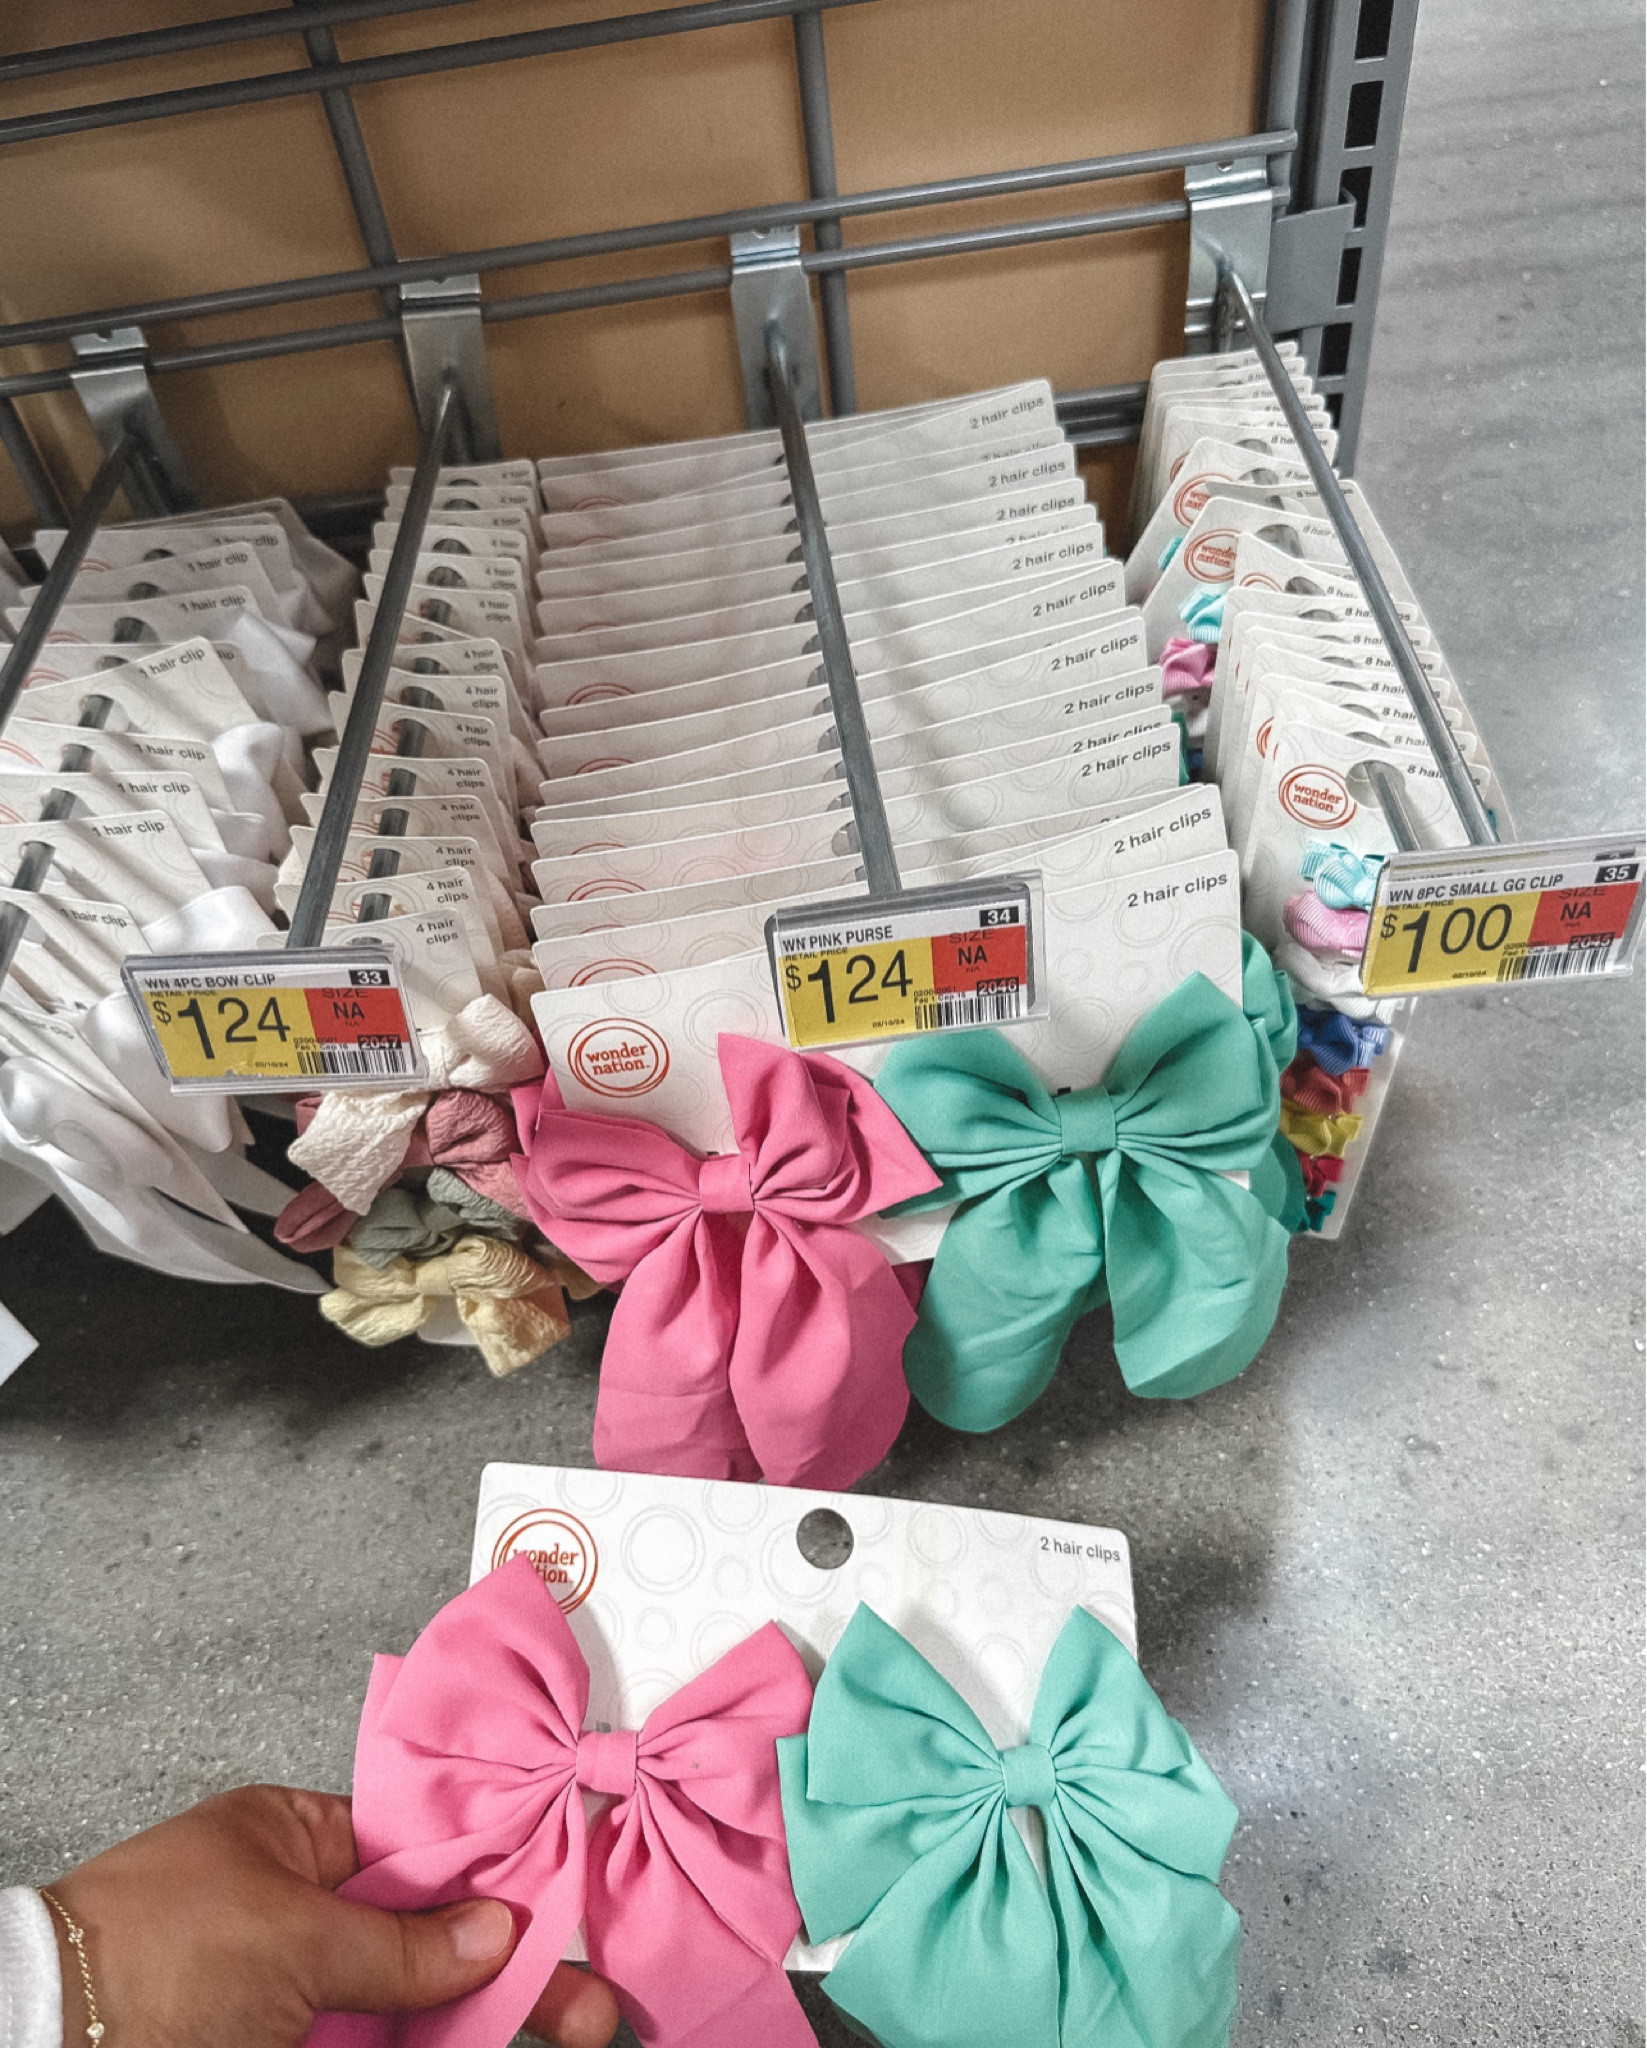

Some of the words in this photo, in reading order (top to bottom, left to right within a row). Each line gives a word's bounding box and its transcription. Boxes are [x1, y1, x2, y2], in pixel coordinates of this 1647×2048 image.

[981, 409, 1008, 426] hair
[1011, 397, 1044, 415] clips
[988, 476, 997, 487] 2
[1000, 469, 1029, 485] hair
[1032, 461, 1066, 477] clips
[996, 510, 1006, 520] 2
[1009, 504, 1038, 519] hair
[1041, 497, 1075, 512] clips
[226, 552, 248, 565] clip
[1013, 559, 1021, 570] 2
[1025, 551, 1055, 567] hair
[1058, 542, 1094, 558] clips
[220, 595, 246, 607] clip
[1032, 604, 1042, 617] 2
[1046, 594, 1076, 613] hair
[1080, 581, 1115, 600] clips
[1345, 608, 1352, 616] 8
[1355, 608, 1372, 617] ha
[1052, 658, 1060, 671] 2
[1065, 648, 1096, 667] hair
[1100, 634, 1138, 654] clips
[139, 668, 149, 679] 1
[149, 658, 176, 676] hair
[180, 647, 206, 665] clip
[1365, 657, 1372, 665] 8
[1371, 683, 1379, 691] 8
[1064, 702, 1074, 715] 2
[1078, 694, 1111, 710] hair
[1115, 682, 1154, 700] clips
[1382, 707, 1390, 716] 8
[465, 725, 489, 734] hair
[463, 737, 491, 747] clips
[1073, 741, 1083, 753] 2
[1087, 732, 1120, 749] hair
[1394, 735, 1402, 744] 8
[1406, 736, 1427, 746] hai
[135, 743, 144, 753] 1
[149, 744, 174, 757] hair
[179, 748, 206, 761] clip
[1082, 764, 1092, 777] 2
[1096, 755, 1129, 773] hair
[1132, 741, 1171, 761] clips
[447, 768, 454, 776] 4
[457, 768, 482, 777] hair
[1407, 764, 1416, 774] 8
[1419, 766, 1441, 778] hai
[117, 783, 126, 793] 1
[129, 782, 159, 793] hair
[163, 782, 191, 795] clip
[456, 780, 485, 788] clips
[1294, 784, 1343, 804] wonder
[1293, 794, 1334, 813] nation
[92, 827, 101, 837] 1
[104, 823, 133, 835] hair
[137, 820, 165, 834] clip
[1114, 840, 1125, 854] 2
[1129, 826, 1164, 848] hair
[1169, 808, 1212, 832] clips
[447, 846, 473, 855] hair
[445, 858, 476, 867] clips
[1604, 866, 1631, 881] 35
[427, 882, 435, 891] 4
[438, 879, 464, 889] hair
[1127, 893, 1139, 908] 2
[1143, 885, 1180, 904] hair
[1184, 873, 1227, 894] clips
[1389, 890, 1413, 902] WN
[1417, 886, 1445, 899] 8PC
[1449, 881, 1499, 896] SMALL
[1503, 878, 1526, 892] GG
[1530, 874, 1563, 888] CLIP
[1559, 887, 1607, 899] SIZE
[437, 892, 469, 903] clips
[60, 909, 69, 918] 1
[72, 909, 98, 921] hair
[101, 912, 128, 927] clip
[987, 909, 1010, 924] 34
[1560, 901, 1592, 920] NA
[416, 923, 424, 933] 4
[427, 919, 454, 930] hair
[426, 932, 459, 945] clips
[783, 938, 805, 952] WN
[810, 933, 842, 949] PINK
[846, 925, 893, 943] PURSE
[950, 929, 995, 943] SIZE
[786, 952, 818, 961] RETAIL
[821, 947, 848, 956] PRICE
[958, 945, 988, 966] NA
[145, 978, 170, 989] WN
[173, 977, 202, 988] 4PC
[205, 975, 239, 988] BOW
[244, 973, 276, 986] CLIP
[357, 971, 382, 984] 33
[322, 988, 368, 998] SIZE
[978, 979, 1016, 996] 2046
[333, 1001, 365, 1019] NA
[359, 1036, 401, 1050] 2047
[585, 1042, 648, 1063] wonder
[592, 1059, 646, 1075] nation
[1041, 1536, 1049, 1551] 2
[1053, 1539, 1083, 1555] hair
[1086, 1543, 1121, 1563] clips
[535, 1565, 568, 1583] tion
